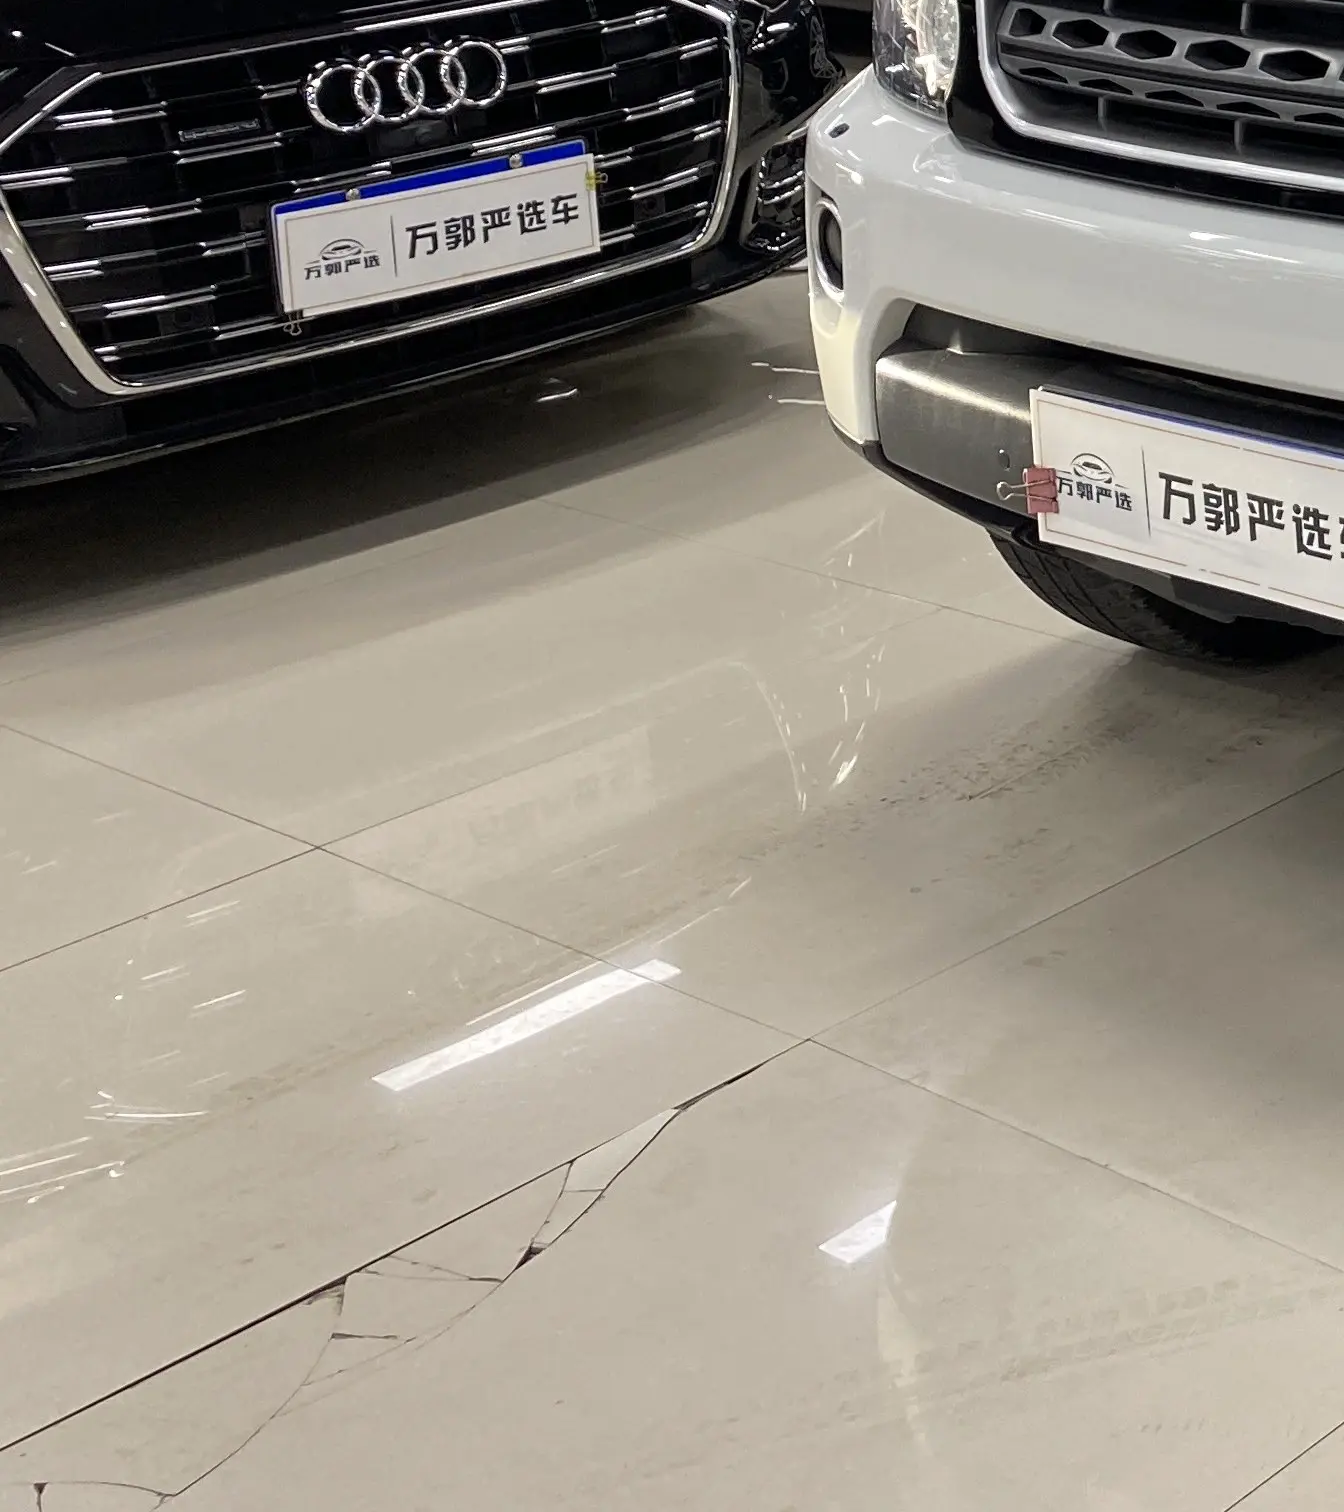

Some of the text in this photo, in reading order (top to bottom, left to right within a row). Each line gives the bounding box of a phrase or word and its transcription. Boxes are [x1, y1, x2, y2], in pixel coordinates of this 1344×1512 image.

[405, 193, 579, 260] 万郭严选车
[303, 254, 380, 281] 万郭严选
[1056, 475, 1133, 512] 万郭严选
